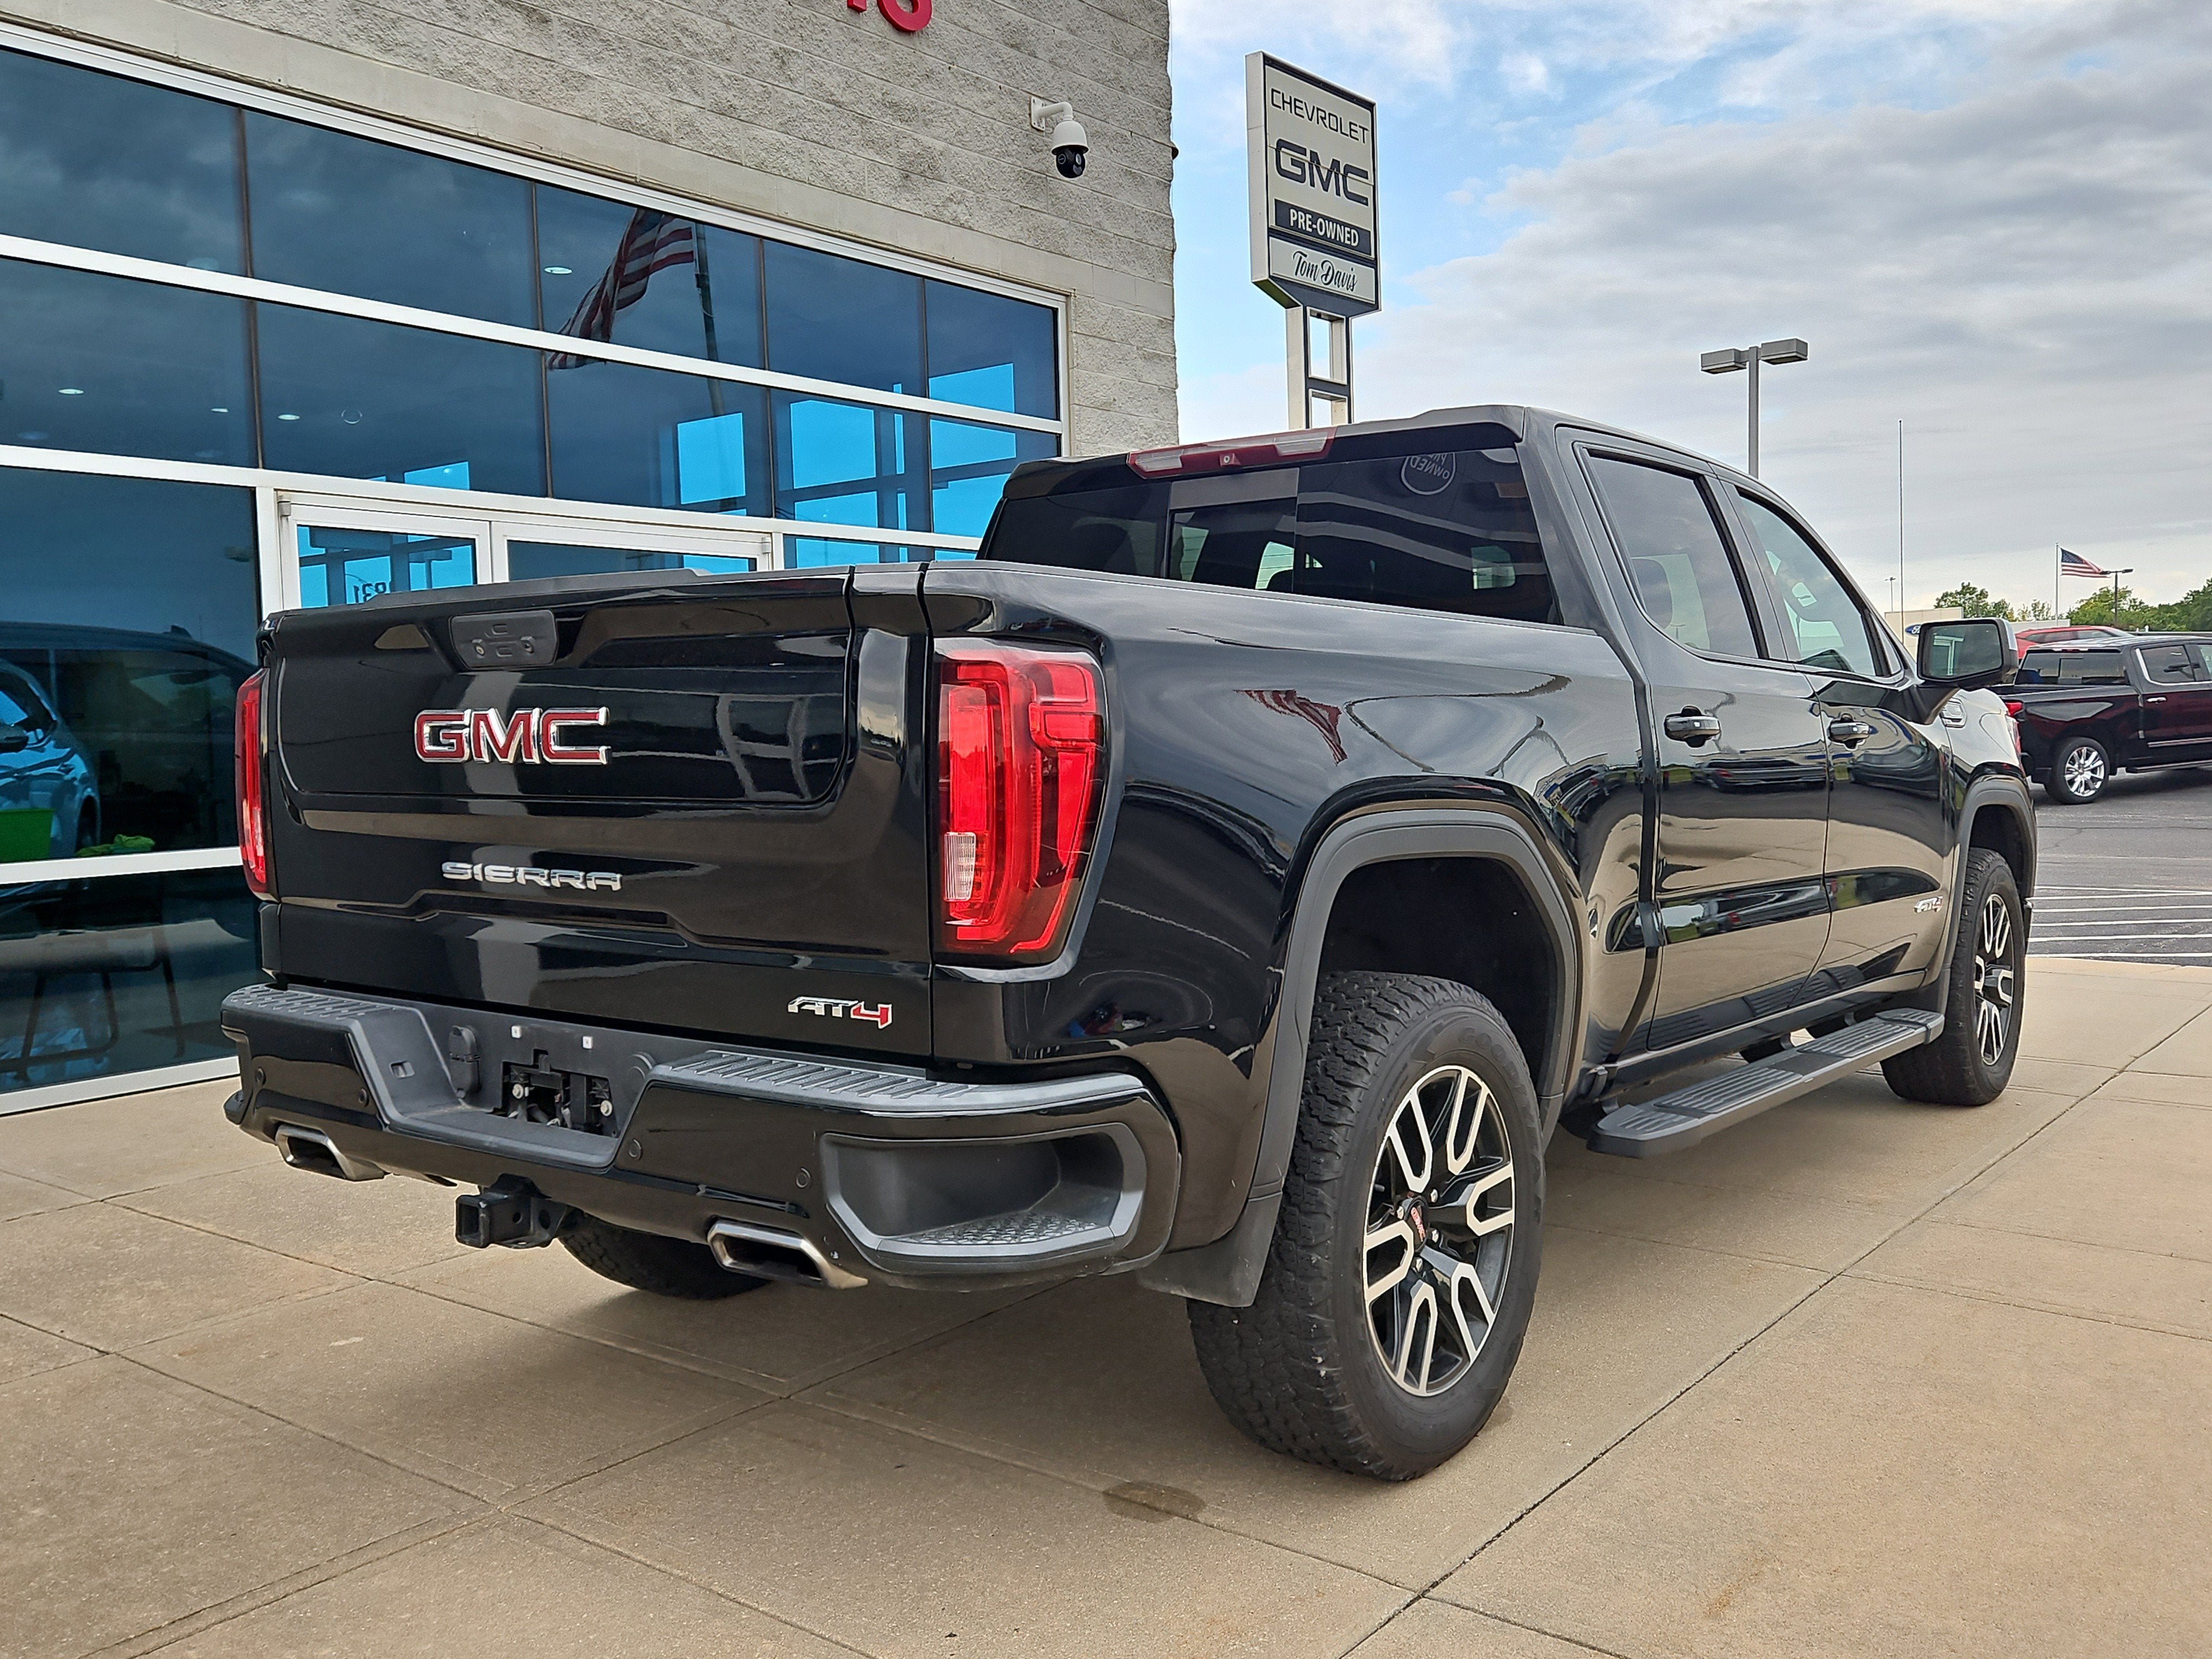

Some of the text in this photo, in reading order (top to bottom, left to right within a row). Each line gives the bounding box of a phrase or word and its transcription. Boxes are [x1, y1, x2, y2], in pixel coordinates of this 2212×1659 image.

[1271, 88, 1368, 144] CHEVROLET
[1276, 138, 1369, 207] GMC
[1290, 208, 1359, 247] PRE-OWNED
[1293, 250, 1358, 292] Tom Davis
[414, 707, 612, 765] GMC
[441, 861, 623, 891] SIERRA
[788, 996, 892, 1029] AT4
